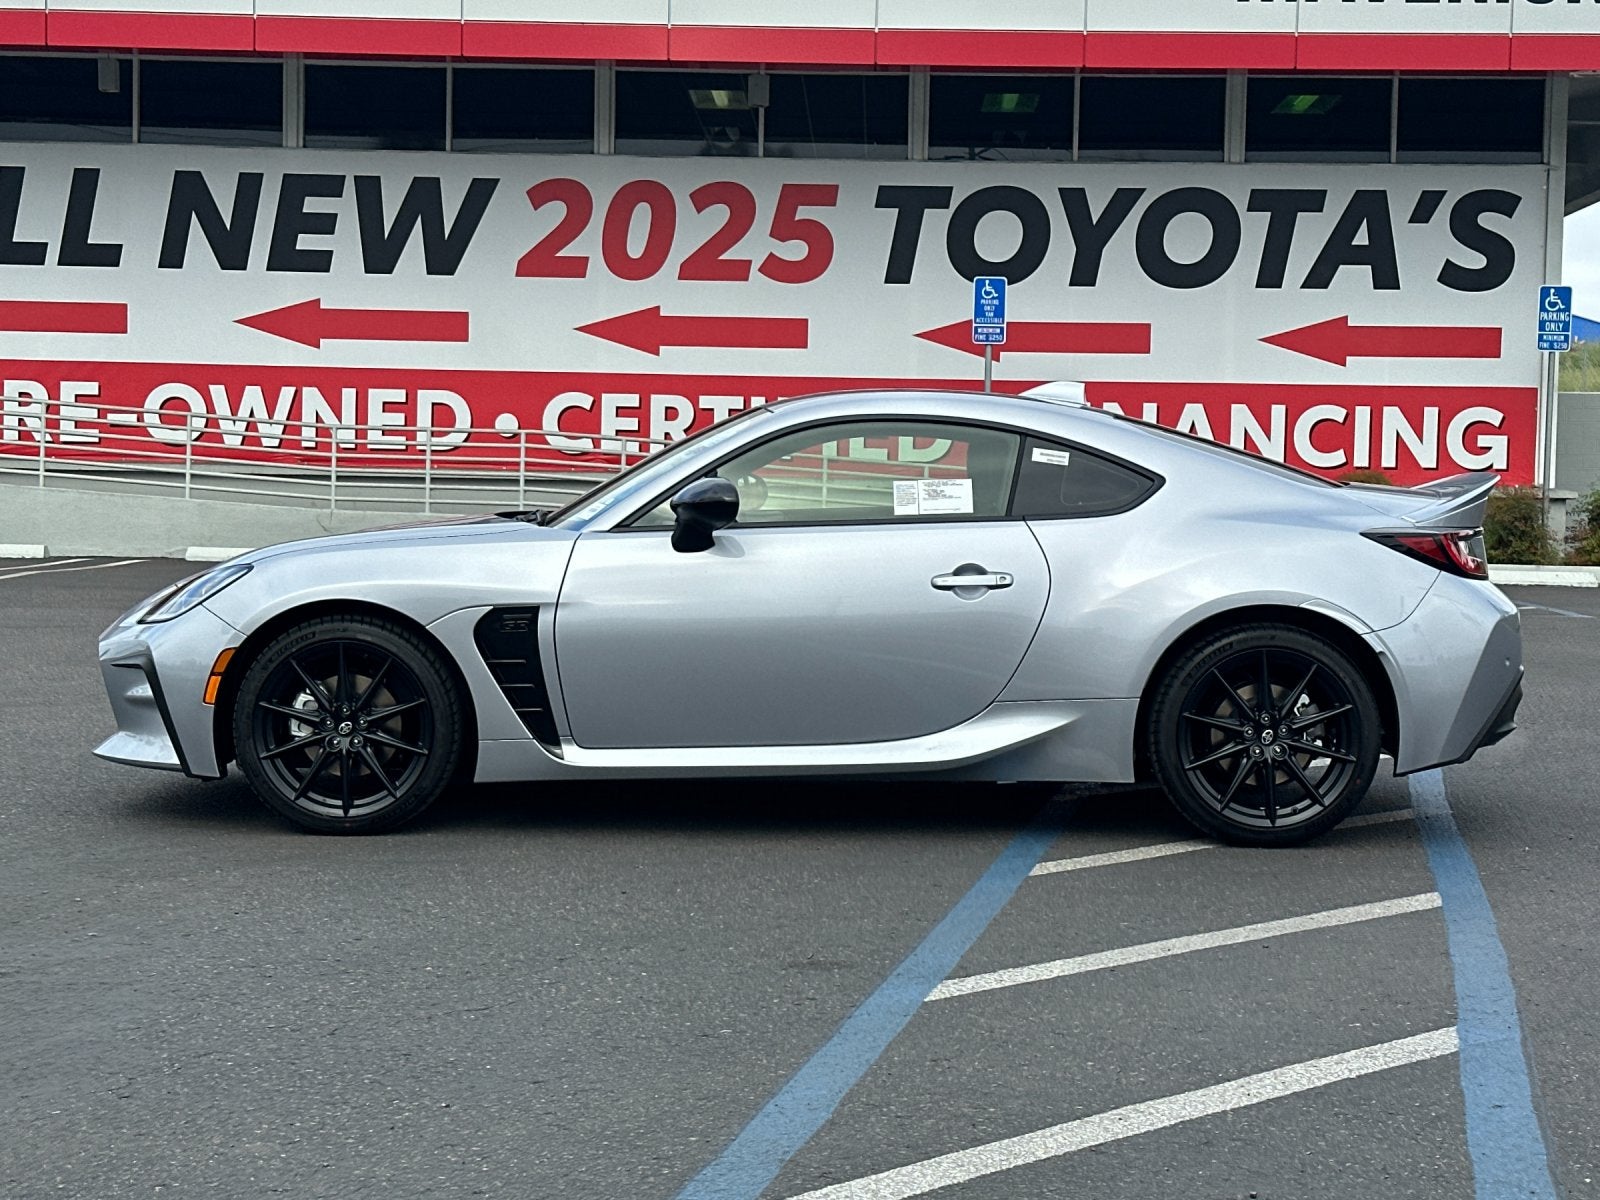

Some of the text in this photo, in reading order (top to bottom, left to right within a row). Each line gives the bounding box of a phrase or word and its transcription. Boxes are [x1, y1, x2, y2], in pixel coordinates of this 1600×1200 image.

[157, 170, 500, 276] NEW
[516, 180, 837, 283] 2025
[875, 185, 1522, 292] TOYOTA'S
[1540, 311, 1569, 321] PARKING
[1545, 322, 1564, 331] ONLY
